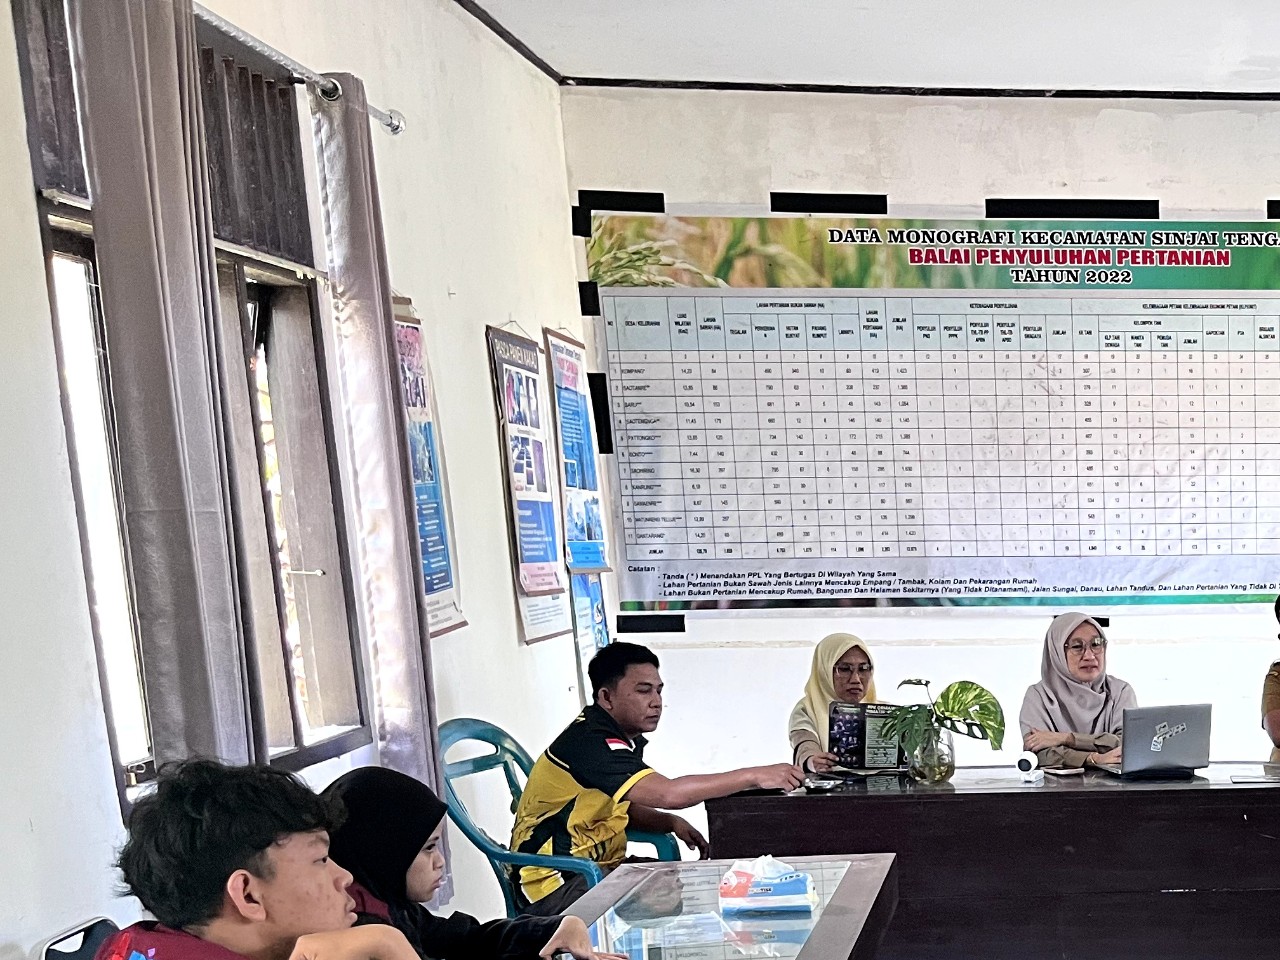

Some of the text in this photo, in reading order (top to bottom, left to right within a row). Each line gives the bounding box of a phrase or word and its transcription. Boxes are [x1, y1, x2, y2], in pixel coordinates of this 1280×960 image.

[828, 229, 883, 244] DATA
[887, 229, 1016, 245] MONOGRAFI
[1020, 230, 1147, 245] KECAMATAN
[1151, 231, 1219, 246] SINJAI
[909, 248, 1230, 266] BALAI PENYULUHAN PERTANIAN
[1011, 269, 1132, 283] TAHUN 2022
[969, 578, 1010, 586] Pekarangan
